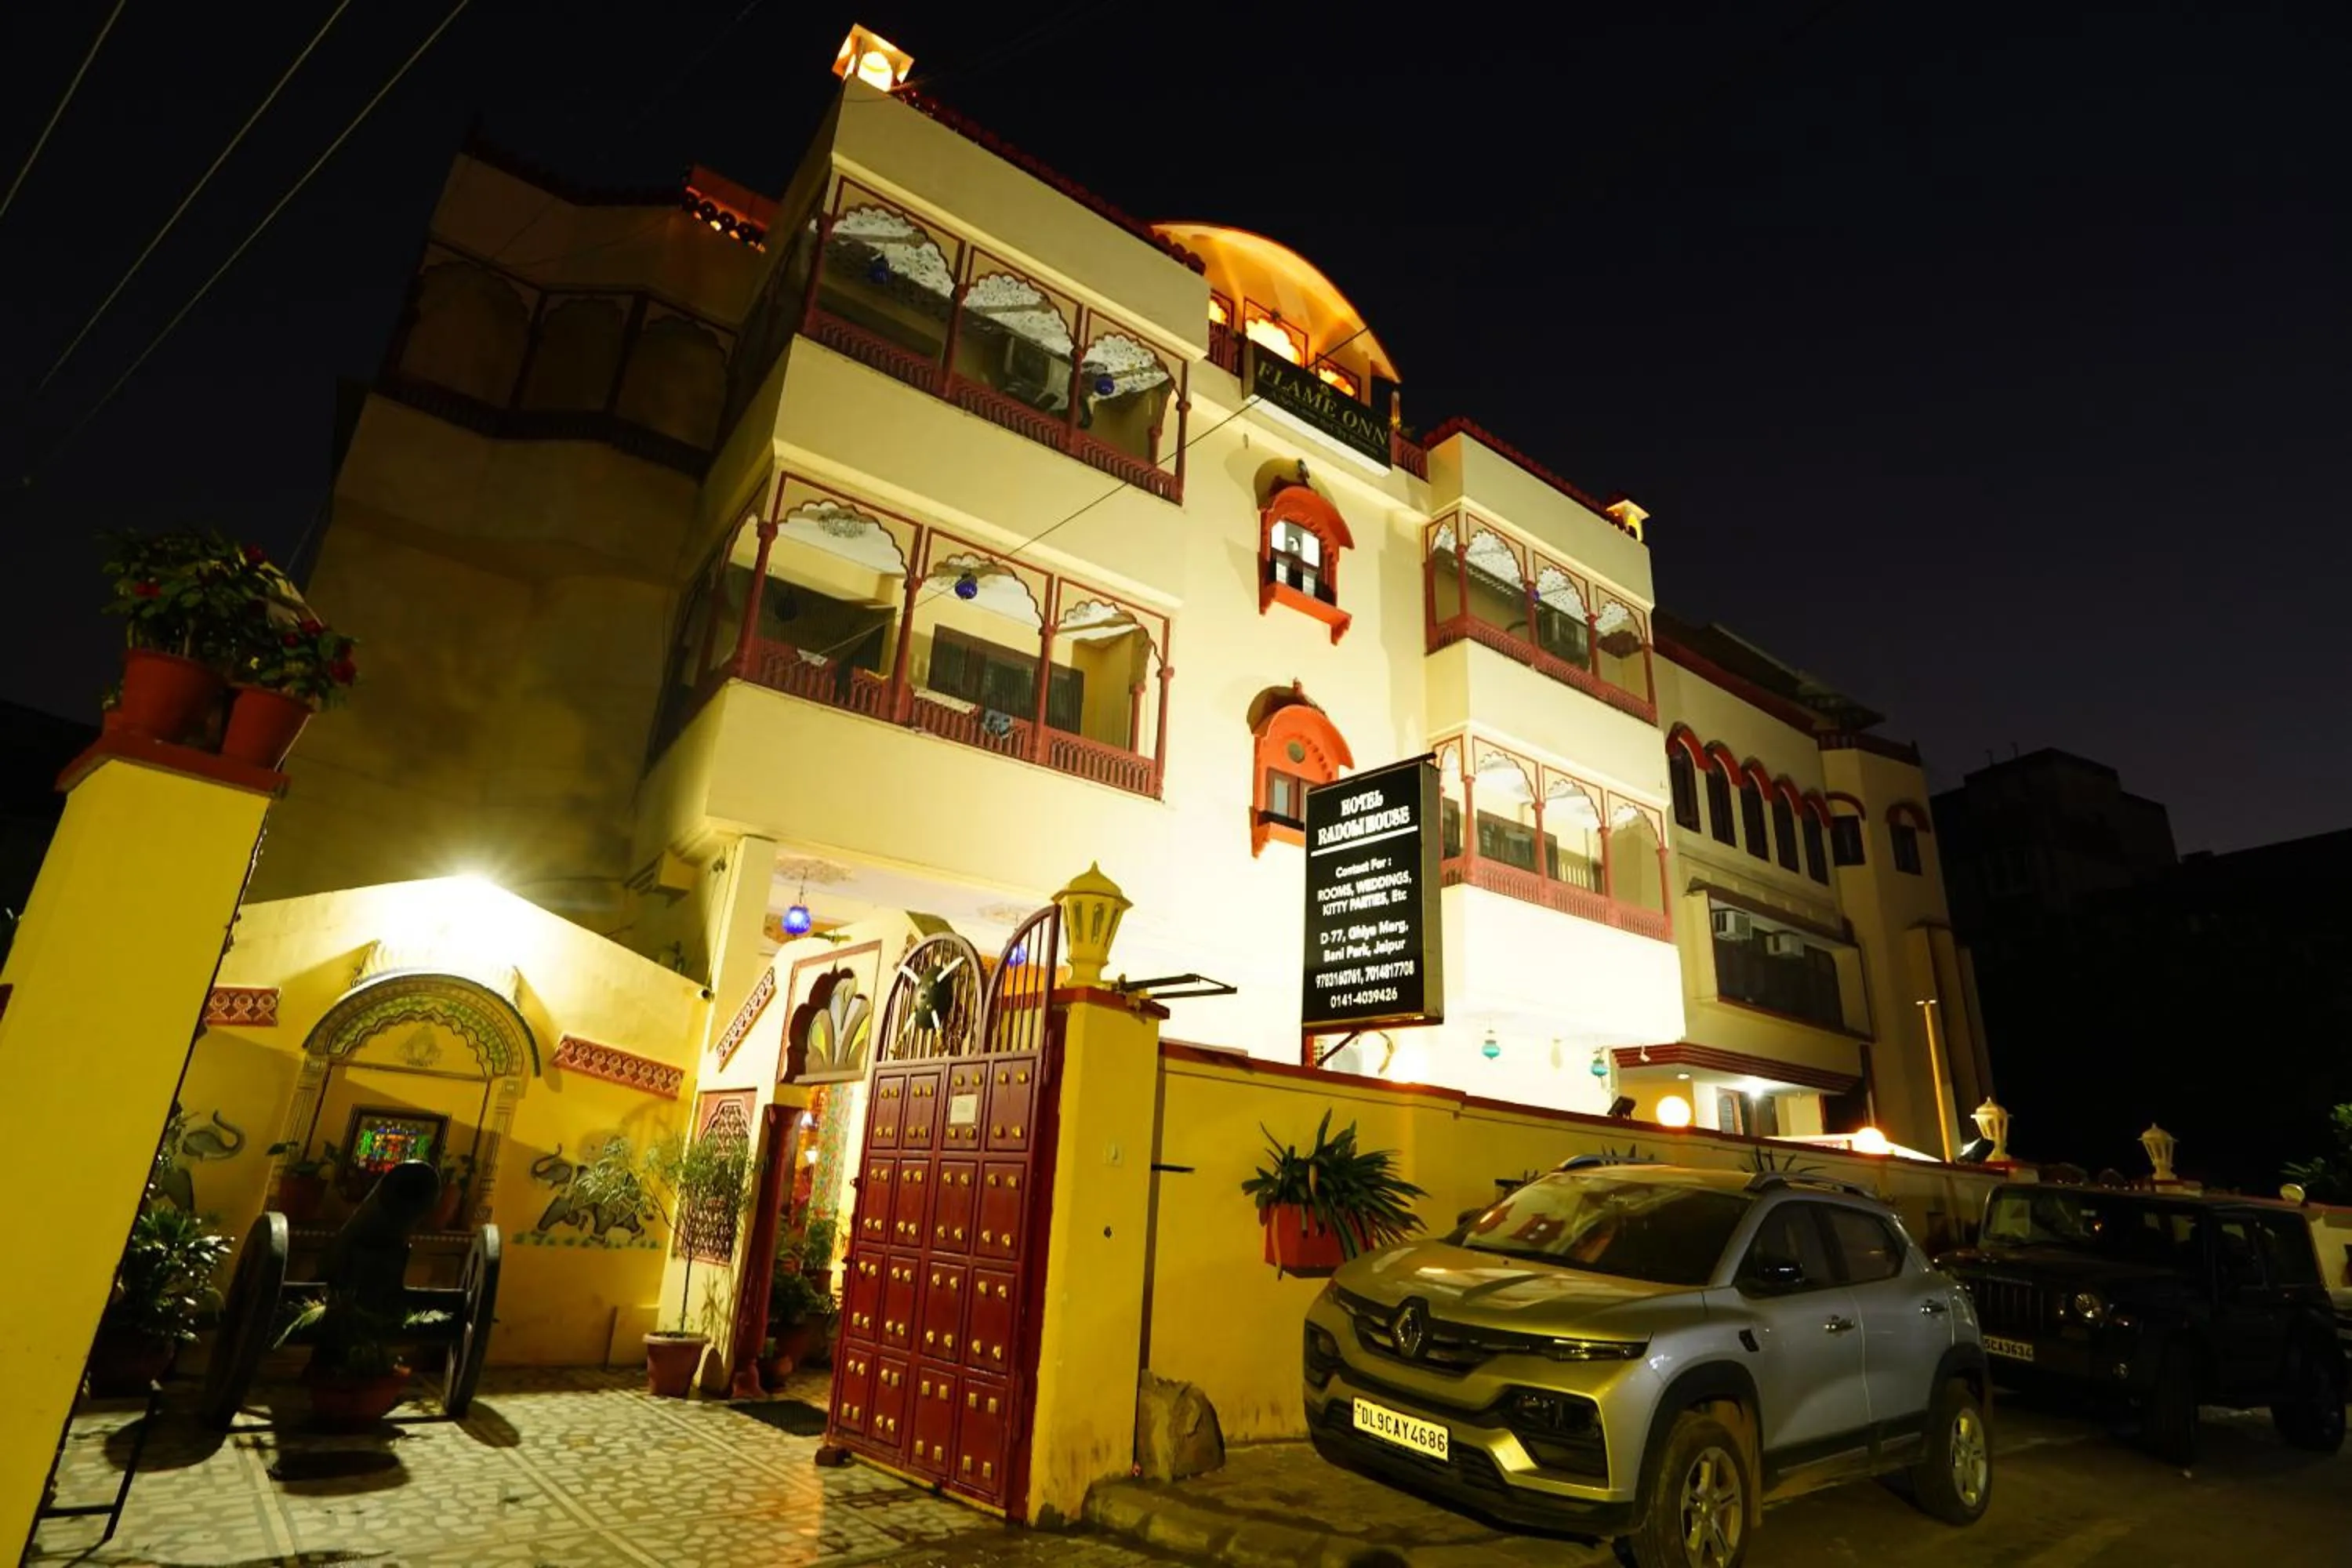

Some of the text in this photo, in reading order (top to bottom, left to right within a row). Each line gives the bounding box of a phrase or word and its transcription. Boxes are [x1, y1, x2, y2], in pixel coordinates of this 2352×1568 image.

[1258, 361, 1339, 418] FLAME
[1342, 410, 1388, 445] ONN
[1341, 790, 1384, 816] HOTEL
[1365, 805, 1410, 833] HOUSE
[1335, 861, 1370, 878] Contact
[1370, 858, 1387, 871] For
[1317, 870, 1412, 902] ROOMS, WEDDINGS,
[1323, 889, 1407, 916] KITTY PARTIES, Etc
[1378, 920, 1409, 934] Marg,
[1323, 939, 1406, 963] Bani Park, Jaipur
[1330, 987, 1398, 1008] 0141-4039426
[1361, 1406, 1446, 1453] DL9CAY4686
